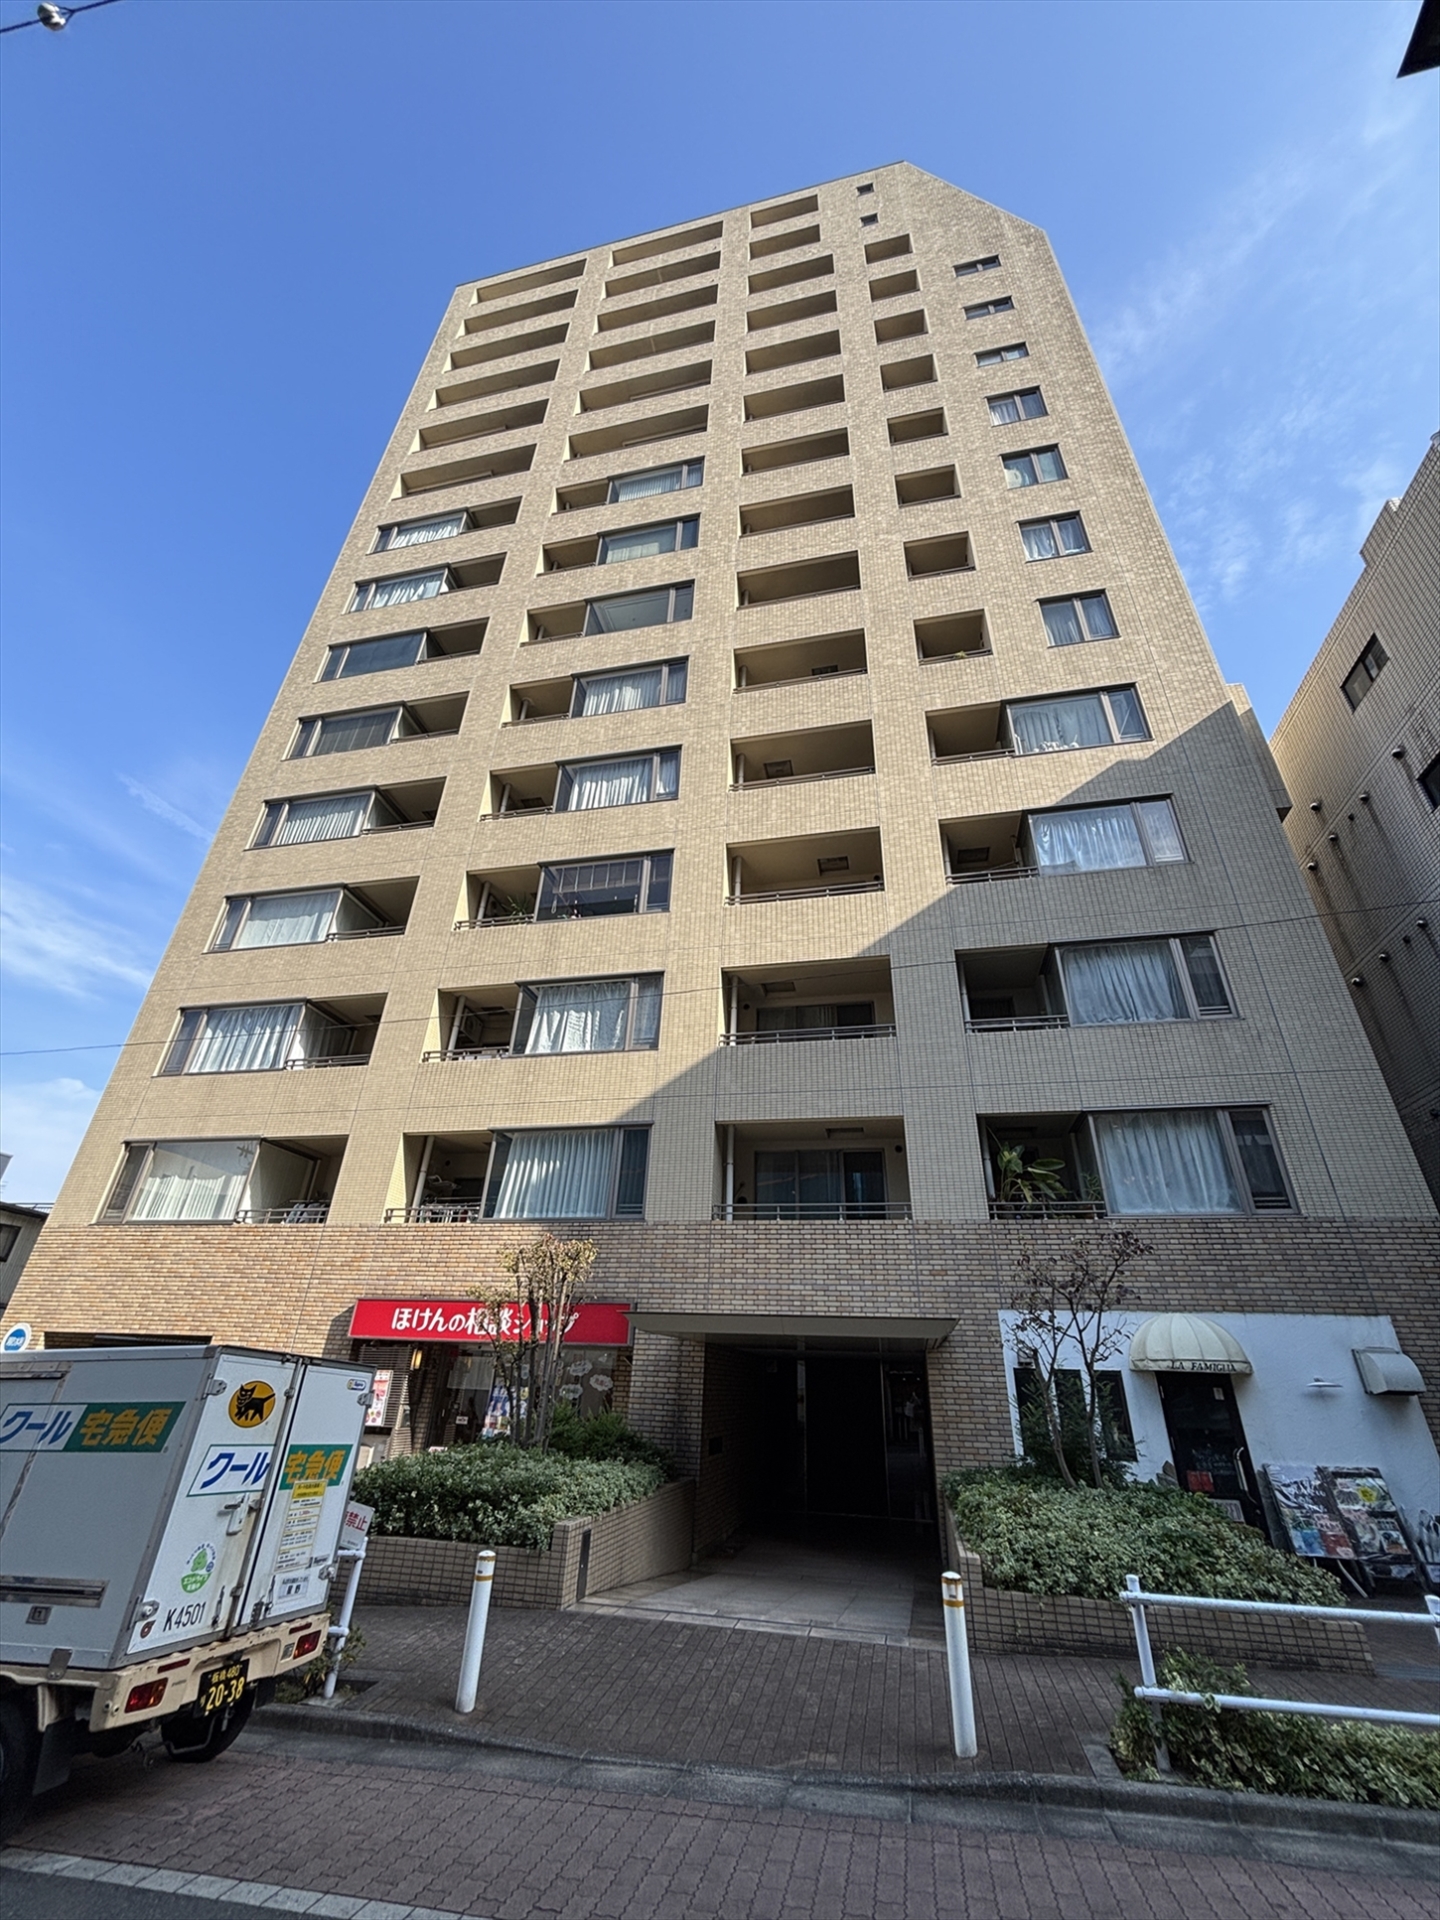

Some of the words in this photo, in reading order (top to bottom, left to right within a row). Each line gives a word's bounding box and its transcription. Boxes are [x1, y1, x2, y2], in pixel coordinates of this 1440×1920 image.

[391, 1307, 580, 1336] ほけんの相談シプ
[1170, 1360, 1185, 1370] LA
[1191, 1361, 1237, 1372] FAMIGLIA
[200, 1451, 270, 1490] クール
[284, 1450, 345, 1485] 宅急便
[345, 1511, 368, 1532] 禁止
[163, 1601, 206, 1632] K4501
[205, 1676, 245, 1711] 20-38
